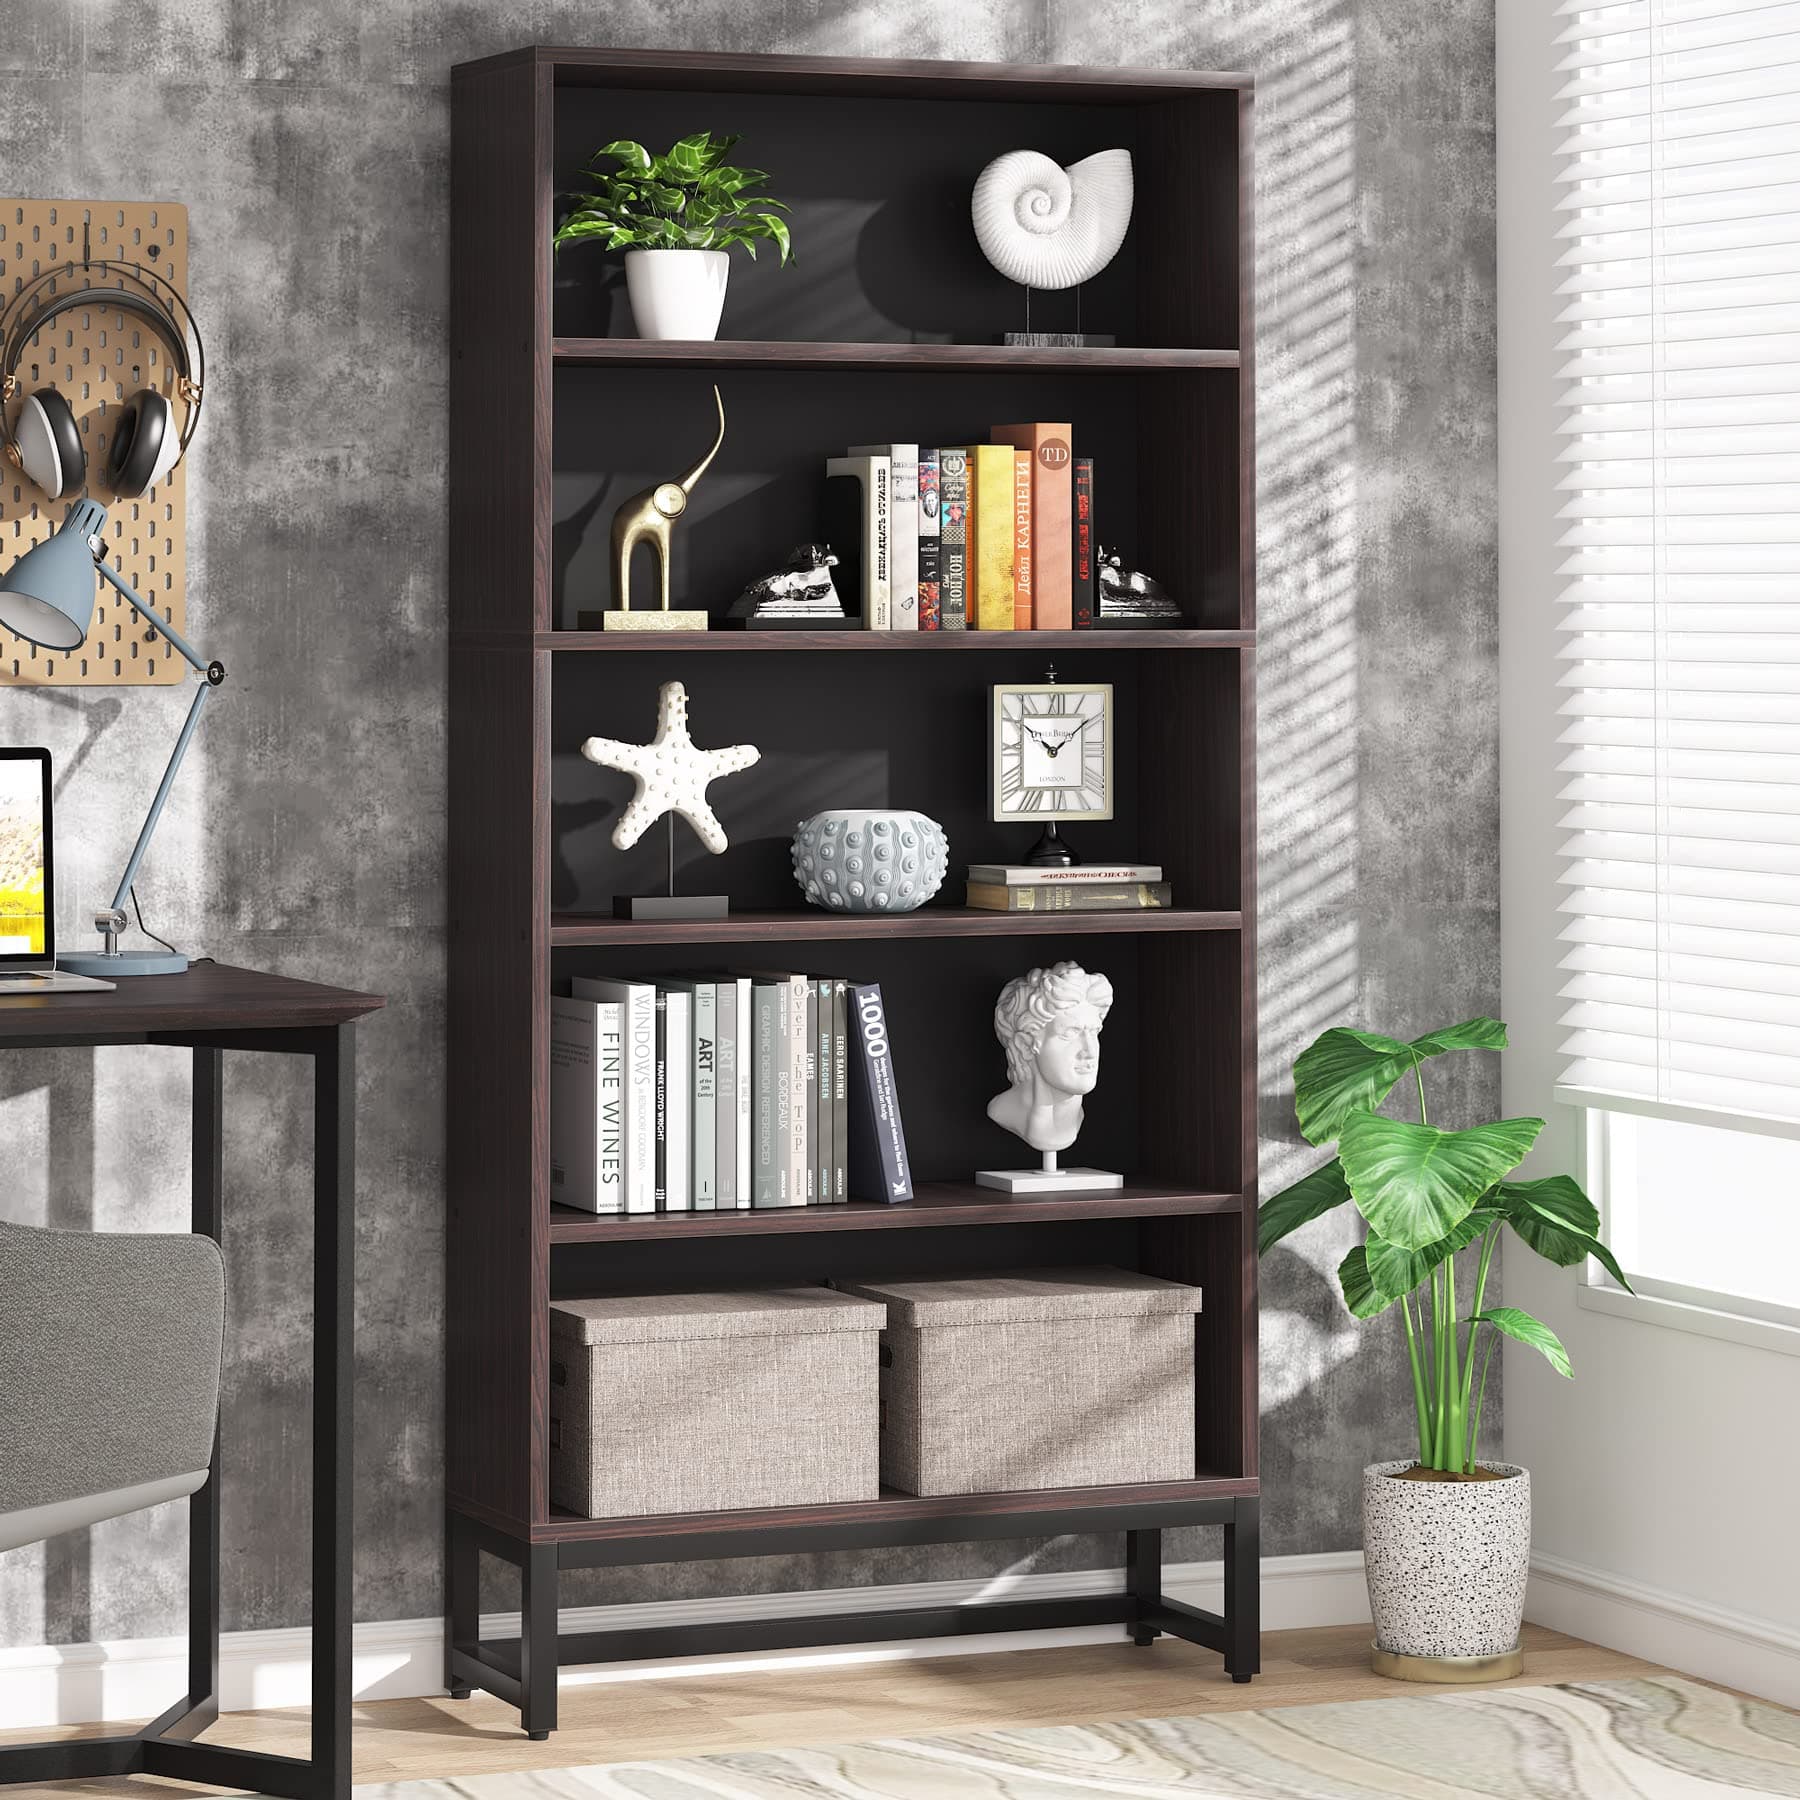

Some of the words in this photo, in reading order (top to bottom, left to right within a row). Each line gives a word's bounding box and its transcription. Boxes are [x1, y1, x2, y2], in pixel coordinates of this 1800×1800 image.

[1042, 447, 1068, 462] TD
[1016, 461, 1030, 550] КАРНЕГИ
[949, 554, 965, 607] ЛОНДОН
[1017, 556, 1031, 595] Дейл
[761, 1005, 772, 1053] GRAPHIC
[794, 984, 804, 1037] Over
[859, 992, 888, 1058] 1000
[634, 993, 651, 1085] WINDOWS
[699, 1037, 713, 1072] ART
[719, 1037, 735, 1072] ART
[821, 1033, 830, 1055] ARNE
[836, 1035, 845, 1056] EERO
[602, 1032, 620, 1088] FINE
[657, 1060, 665, 1085] FRANK
[761, 1055, 772, 1094] DESIGN
[795, 1054, 803, 1092] the
[806, 1052, 815, 1081] EAMES
[821, 1057, 830, 1099] JACOBSEN
[836, 1058, 845, 1100] SAARINEN
[880, 1057, 889, 1077] designs
[657, 1086, 665, 1110] LLOYD
[778, 1071, 790, 1130] BORDEAUX
[884, 1085, 892, 1095] the
[885, 1096, 895, 1117] gardens
[657, 1110, 665, 1142] WRIGHT
[761, 1096, 772, 1166] REFERENCED
[890, 1117, 898, 1128] and
[602, 1100, 620, 1184] WINES
